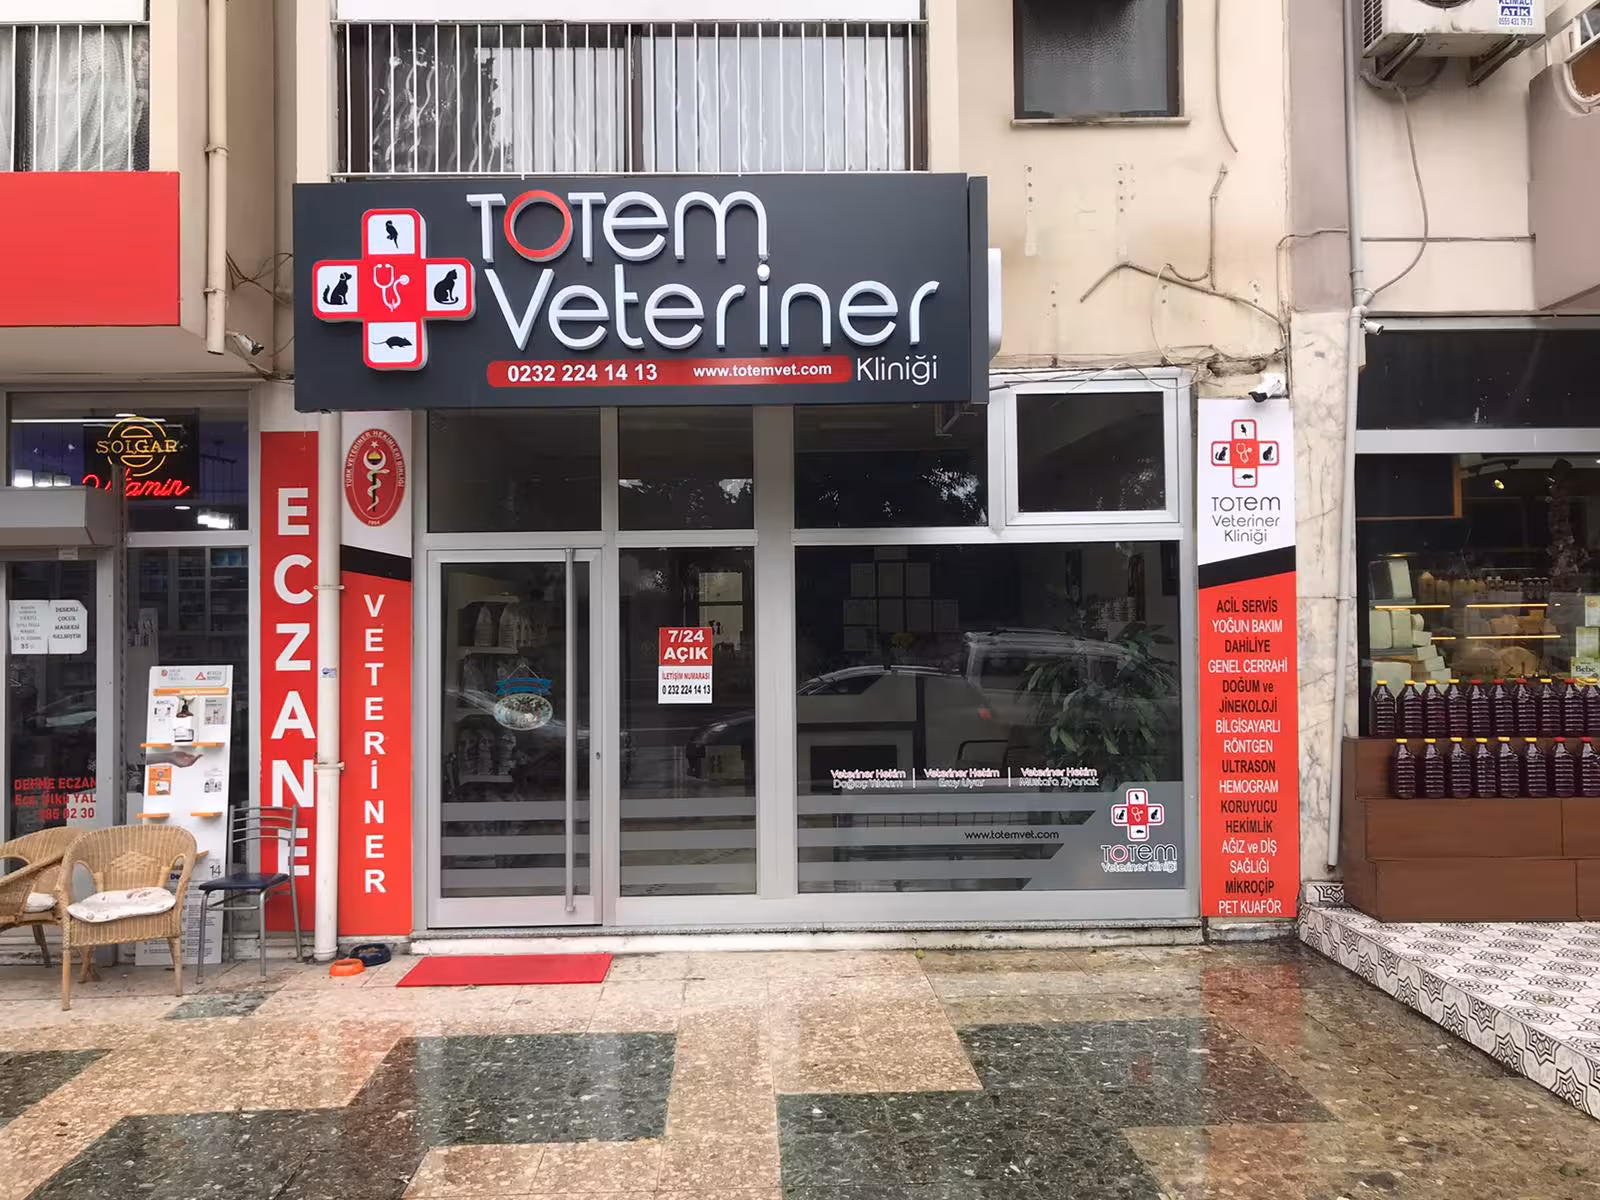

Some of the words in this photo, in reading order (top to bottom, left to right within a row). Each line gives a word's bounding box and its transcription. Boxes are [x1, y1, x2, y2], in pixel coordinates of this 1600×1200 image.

[484, 263, 940, 351] Veteriner
[508, 365, 555, 382] 0232
[562, 364, 598, 381] 224
[604, 364, 628, 381] 14
[635, 363, 657, 380] 13
[693, 363, 832, 377] www.totemvet.com
[857, 354, 938, 385] Kliniği
[96, 439, 181, 454] SOLGAR
[1212, 513, 1280, 528] Veteriner
[1224, 529, 1267, 545] Kliniği
[1217, 596, 1239, 612] ACİL
[1242, 596, 1278, 612] SERVİS
[1212, 617, 1249, 633] YOĞUN
[1251, 619, 1283, 633] BAKIM
[668, 629, 704, 643] 7/24
[1225, 636, 1270, 653] DAHİLİYE
[663, 646, 708, 663] AÇIK
[1208, 659, 1241, 673] GENEL
[1243, 657, 1288, 673] CERRAHİ
[270, 487, 316, 876] ECZANE
[662, 685, 666, 694] 0
[668, 685, 679, 694] 232
[681, 685, 692, 694] 224
[694, 685, 701, 694] 14
[703, 685, 711, 694] 13
[1223, 677, 1260, 692] DOĞUM
[1263, 682, 1274, 693] ve
[1219, 696, 1277, 713] JİNEKOLOJİ
[1216, 717, 1281, 733] BİLGİSAYARLI
[363, 593, 387, 893] VETERİNER
[1224, 737, 1273, 753] RÖNTGEN
[830, 769, 874, 778] Veteriner
[875, 768, 906, 778] Hekim
[923, 768, 968, 778] Veteriner
[969, 767, 1000, 778] Hekim
[1020, 767, 1064, 777] Veteriner
[1065, 767, 1097, 776] Hekim
[1222, 760, 1275, 773] ULTRASON
[1219, 779, 1279, 793] HEMOGRAM
[81, 807, 95, 818] 30
[1221, 800, 1277, 813] KORUYUCU
[1226, 817, 1273, 833] HEKİMLİK
[964, 829, 1060, 840] www.totemvet.com
[1222, 837, 1245, 853] AĞIZ
[1247, 843, 1258, 853] ve
[1260, 837, 1277, 856] DİŞ
[1101, 861, 1147, 872] Veteriner
[1230, 857, 1269, 873] SAĞLIĞI
[1226, 877, 1274, 896] MİKROÇİP
[1219, 900, 1238, 913] PET
[1240, 898, 1282, 914] KUAFÖR
